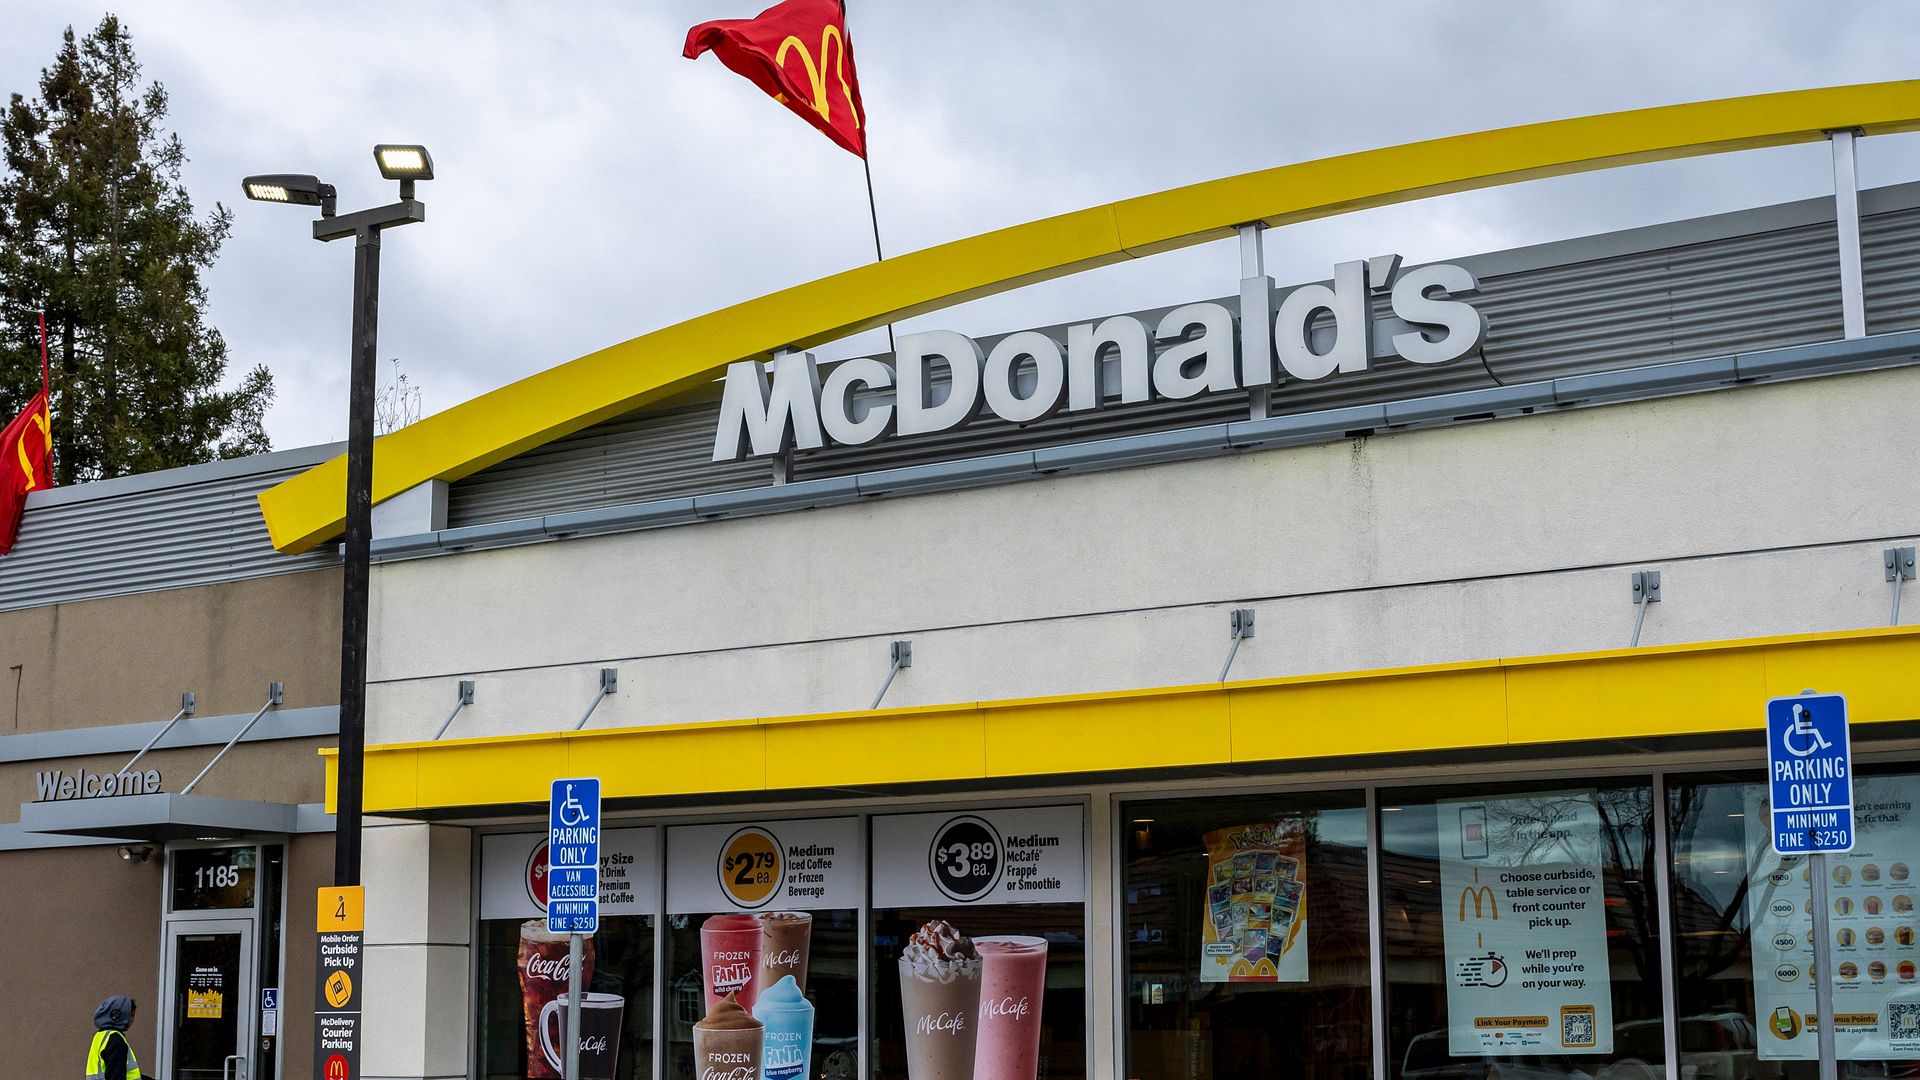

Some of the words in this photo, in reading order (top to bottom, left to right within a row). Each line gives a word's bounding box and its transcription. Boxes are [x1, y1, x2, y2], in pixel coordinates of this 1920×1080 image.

[712, 254, 1484, 461] McDonald's
[1775, 756, 1845, 782] PARKING
[36, 768, 162, 801] Welcome
[1790, 783, 1832, 806] ONLY
[1874, 800, 1911, 811] earning
[1787, 812, 1837, 829] MINIMUM
[1864, 814, 1877, 823] fix
[552, 827, 596, 845] PARKING
[1007, 834, 1059, 848] Medium
[1549, 829, 1573, 840] app.
[1779, 832, 1804, 848] FINE
[1814, 830, 1847, 848] $250
[560, 847, 587, 865] ONLY
[788, 844, 834, 857] Medium
[611, 852, 634, 865] Size
[788, 859, 805, 870] Iced
[806, 858, 832, 870] Coffee
[565, 870, 581, 882] VAN
[606, 866, 626, 878] Drink
[972, 863, 990, 876] ea.
[1007, 863, 1037, 879] Frappé
[1500, 873, 1542, 883] Choose
[1544, 869, 1595, 882] curbside,
[195, 865, 239, 889] 1185
[756, 871, 773, 884] ea.
[788, 874, 797, 883] or
[798, 872, 824, 883] Frozen
[1771, 874, 1789, 882] 1500
[551, 884, 594, 897] ACCESSIBLE
[599, 880, 630, 891] Premium
[1007, 881, 1016, 891] or
[1018, 877, 1061, 891] Smoothie
[599, 893, 610, 903] ast
[610, 892, 635, 903] Coffee
[788, 886, 825, 898] Beverage
[1505, 888, 1534, 898] table
[1536, 886, 1577, 897] service
[1578, 885, 1591, 894] or
[334, 901, 347, 922] 4
[556, 902, 589, 915] MINIMUM
[1512, 903, 1540, 913] front
[1542, 901, 1586, 912] counter
[550, 917, 567, 929] FINE
[573, 916, 594, 930] $250
[1529, 917, 1553, 930] pick
[1555, 917, 1572, 929] up.
[320, 935, 341, 943] Mobile
[342, 934, 359, 943] Order
[1774, 938, 1794, 946] 4500
[321, 944, 358, 955] Curbside
[713, 951, 750, 960] FROZEN
[1525, 949, 1550, 959] We'll
[1552, 951, 1577, 961] prep
[324, 957, 342, 967] Pick
[343, 957, 355, 968] Up
[762, 949, 800, 968] McCafé
[711, 963, 752, 985] FANTA
[1521, 964, 1550, 974] while
[1552, 962, 1584, 975] you're
[714, 985, 726, 993] wild
[725, 985, 743, 993] cherry
[1522, 980, 1536, 988] on
[1537, 979, 1562, 991] your
[1563, 978, 1586, 989] way.
[979, 996, 1029, 1020] McCafé
[320, 1017, 355, 1027] McDelivery
[916, 1011, 965, 1035] McCafé
[1476, 1019, 1493, 1027] Link
[1513, 1018, 1546, 1028] Payment
[322, 1028, 353, 1039] Courier
[765, 1031, 802, 1042] FROZEN
[1852, 1026, 1878, 1035] payment
[322, 1039, 353, 1051] Parking
[708, 1053, 751, 1064] FROZEN
[763, 1044, 804, 1066] FANTA
[765, 1068, 778, 1076] blue
[777, 1067, 803, 1077] raspberry
